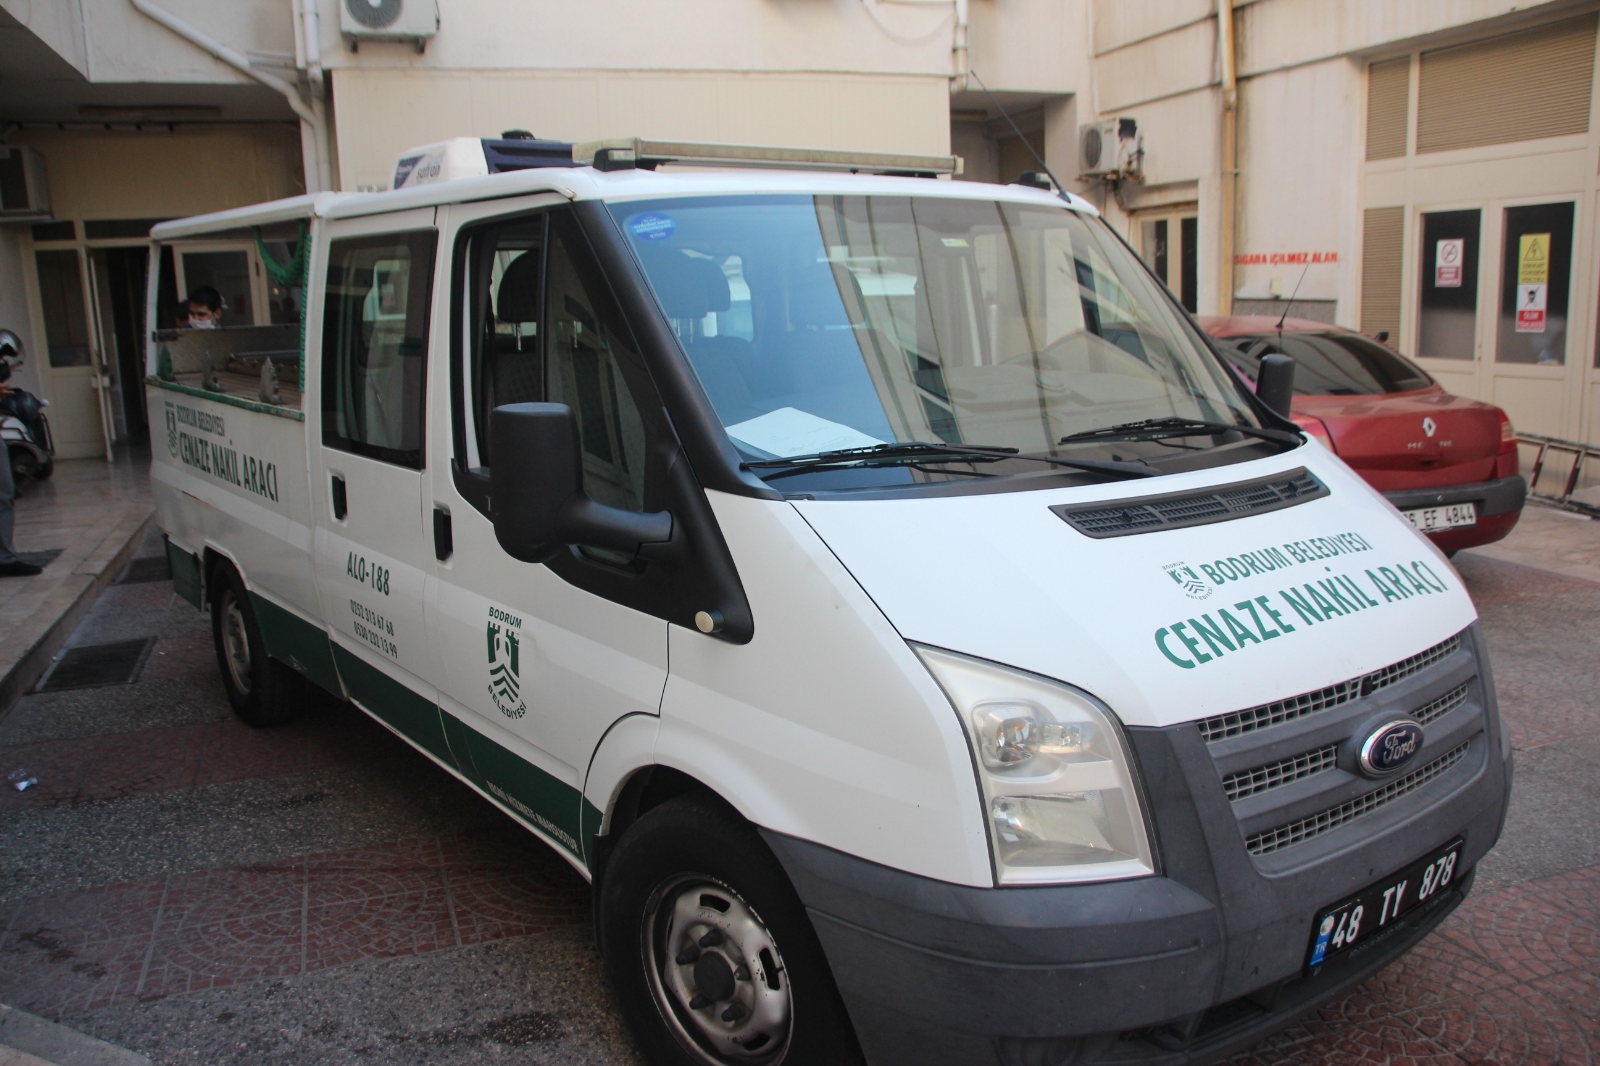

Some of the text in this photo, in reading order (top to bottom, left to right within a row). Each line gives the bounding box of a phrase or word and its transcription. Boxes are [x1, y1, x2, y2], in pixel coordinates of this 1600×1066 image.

[1312, 251, 1338, 264] ALAN
[178, 431, 279, 503] CENAZE NAKİL ARACI
[1423, 508, 1438, 528] EF
[1445, 504, 1475, 525] 4844
[347, 551, 390, 596] ALO-188
[1199, 546, 1293, 586] BODRUM
[488, 606, 523, 630] BODRUM
[1154, 560, 1449, 670] CENAZE NAKİL ARACI
[1383, 729, 1416, 764] Ford
[1331, 905, 1364, 949] 48
[1379, 880, 1407, 926] TY
[1419, 851, 1457, 901] 878
[1315, 941, 1327, 955] TR
